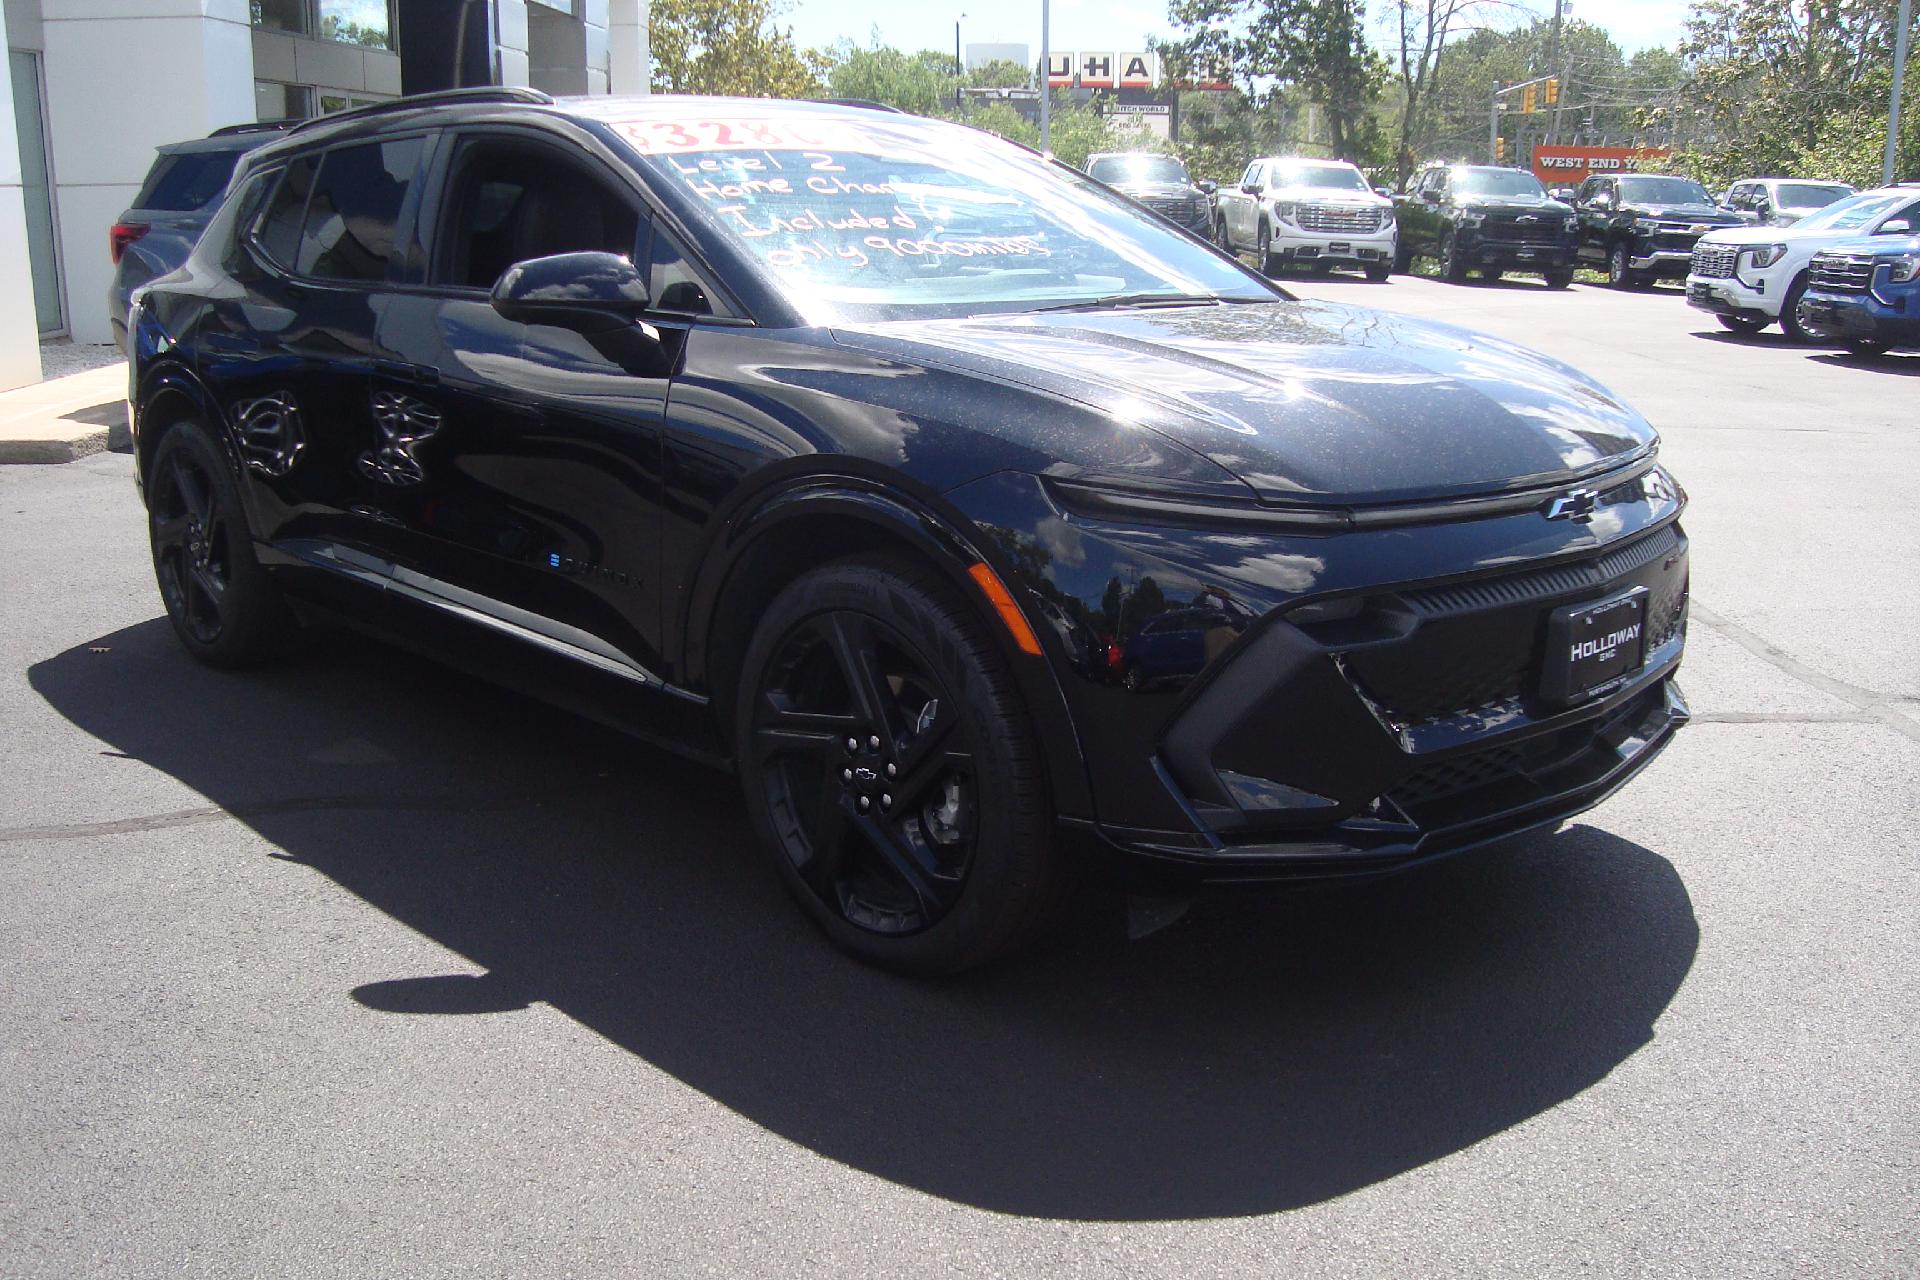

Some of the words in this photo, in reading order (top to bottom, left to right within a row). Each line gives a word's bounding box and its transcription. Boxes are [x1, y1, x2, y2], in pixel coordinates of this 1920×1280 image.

[667, 150, 782, 174] Level
[803, 152, 846, 172] 2
[1540, 156, 1584, 169] WEST
[1587, 158, 1620, 169] END
[685, 176, 793, 200] Home
[1570, 623, 1641, 662] HOLLOWAY
[1599, 649, 1616, 662] GMC
